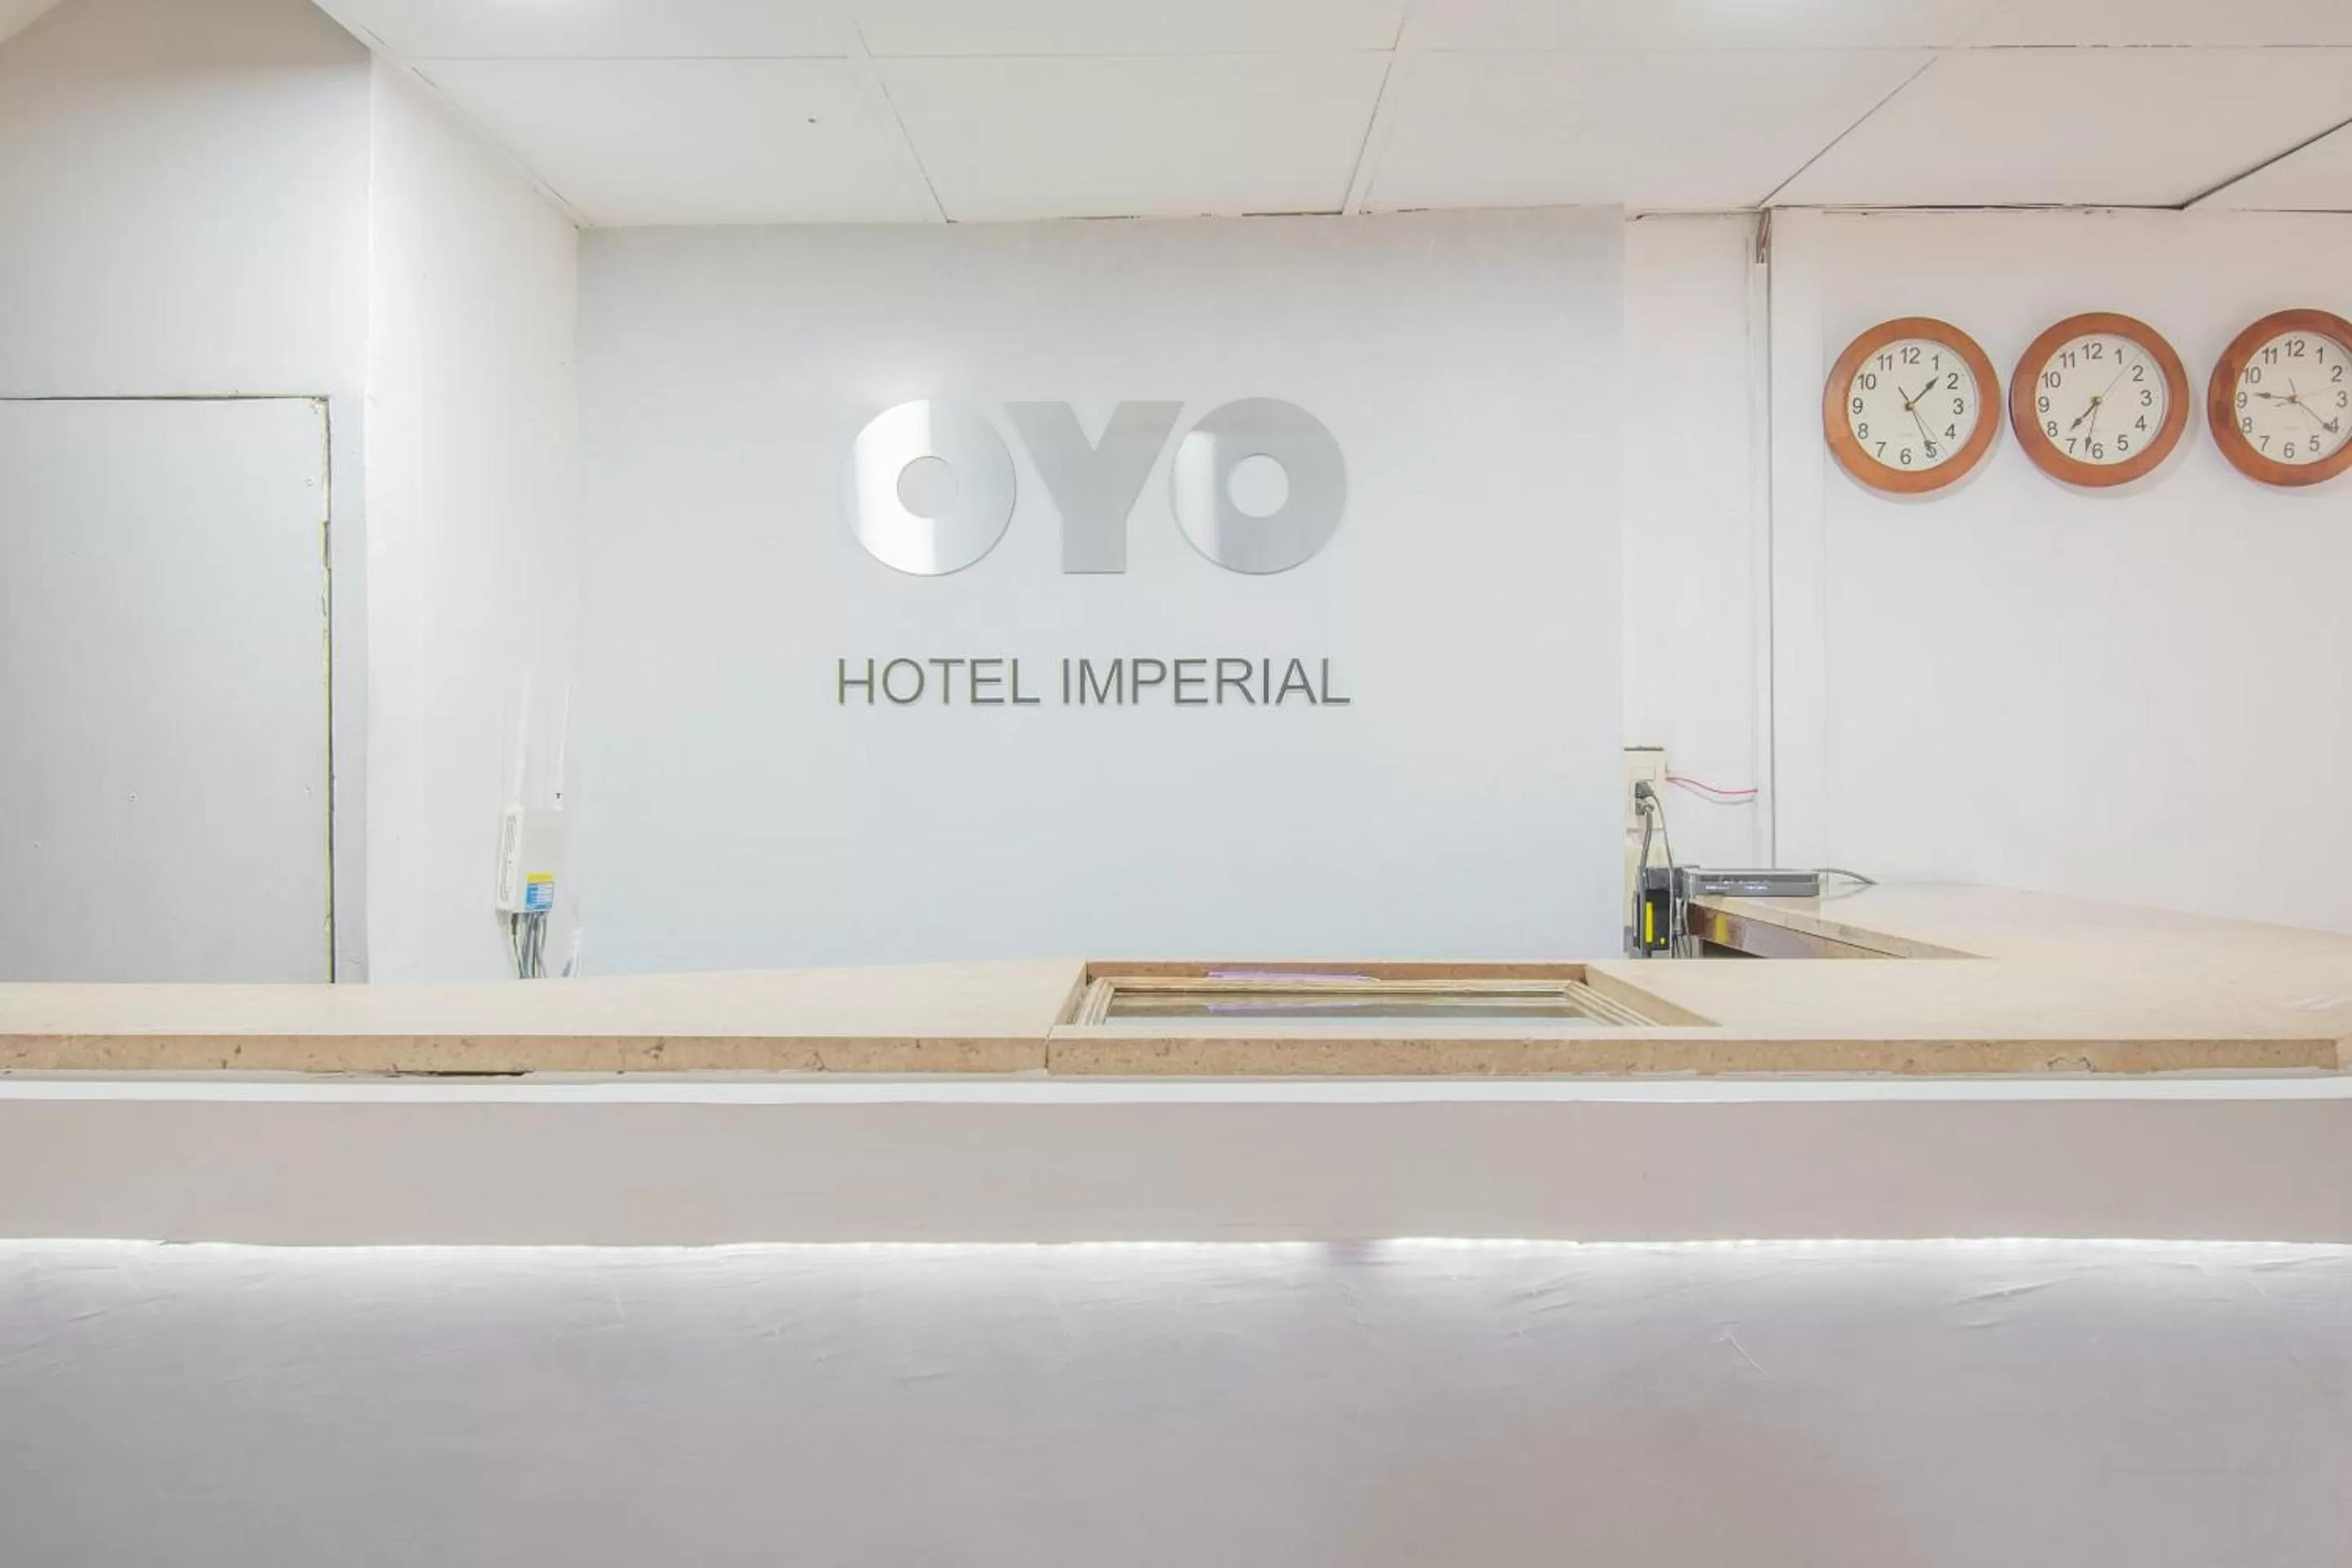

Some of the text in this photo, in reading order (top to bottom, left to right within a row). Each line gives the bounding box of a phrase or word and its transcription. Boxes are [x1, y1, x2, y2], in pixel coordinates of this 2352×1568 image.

[1900, 347, 1920, 364] 12
[2082, 343, 2102, 359] 12
[2115, 349, 2122, 364] 1
[2262, 348, 2278, 364] 11
[2285, 340, 2305, 357] 12
[2316, 346, 2323, 363] 1
[1877, 354, 1892, 371] 11
[1931, 354, 1939, 370] 1
[2060, 351, 2075, 368] 11
[2042, 372, 2061, 388] 10
[2132, 365, 2144, 381] 2
[2244, 367, 2261, 384] 10
[2331, 365, 2342, 382] 2
[1857, 374, 1876, 390] 10
[1947, 373, 1958, 390] 2
[1852, 398, 1863, 414] 9
[2038, 396, 2049, 412] 9
[2140, 390, 2152, 406] 3
[2237, 392, 2247, 408] 9
[2336, 391, 2347, 408] 3
[1953, 399, 1964, 415] 3
[1858, 423, 1869, 439] 8
[1944, 424, 1956, 439] 4
[2047, 421, 2057, 437] 8
[2135, 416, 2146, 431] 4
[2243, 416, 2252, 434] 8
[1875, 442, 1886, 457] 7
[1926, 442, 1937, 458] 5
[2065, 439, 2076, 453] 7
[2117, 434, 2128, 451] 5
[2260, 436, 2270, 452] 7
[2283, 442, 2295, 458] 6
[2310, 435, 2320, 452] 5
[1900, 448, 1912, 465] 6
[2092, 443, 2104, 459] 6
[840, 396, 1348, 576] OYO
[838, 657, 1351, 705] HOTEL IMPERIAL
